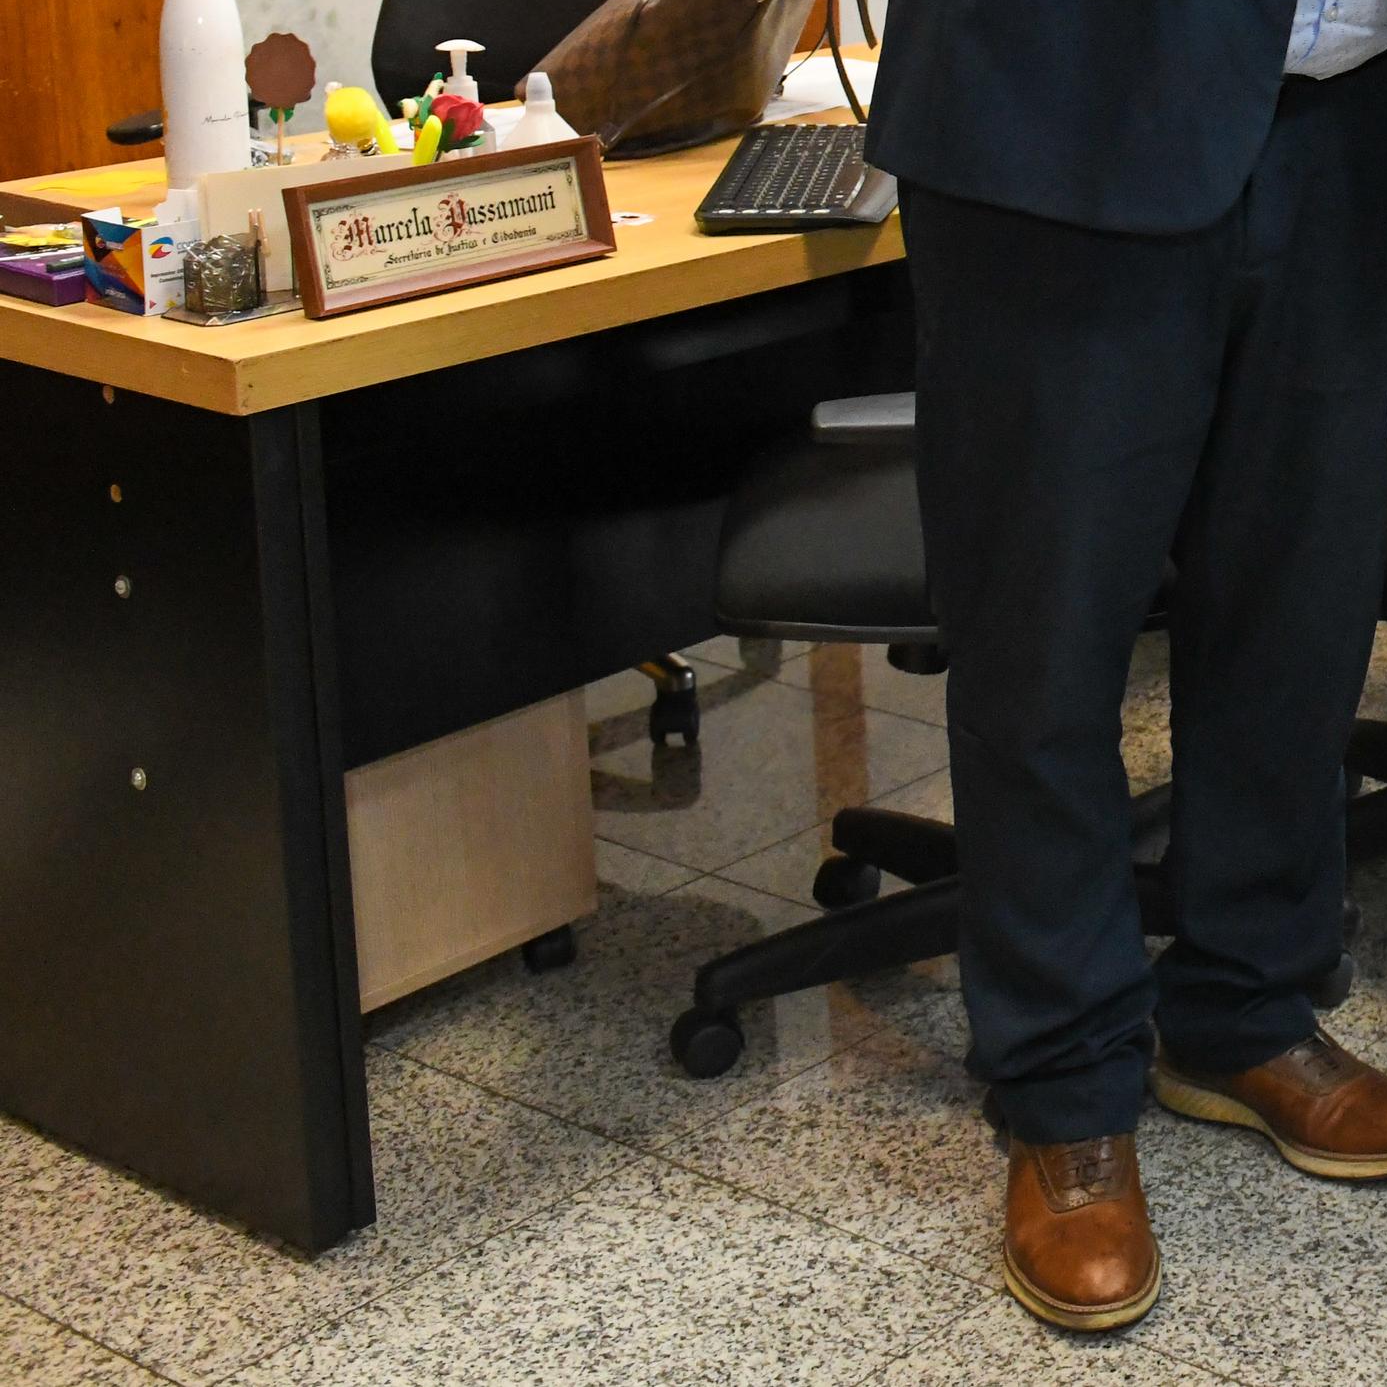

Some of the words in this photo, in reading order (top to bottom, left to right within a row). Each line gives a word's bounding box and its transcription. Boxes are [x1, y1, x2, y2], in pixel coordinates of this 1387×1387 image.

[333, 207, 434, 255] Marcela
[436, 185, 556, 237] Passamani
[491, 226, 537, 244] Cidadania
